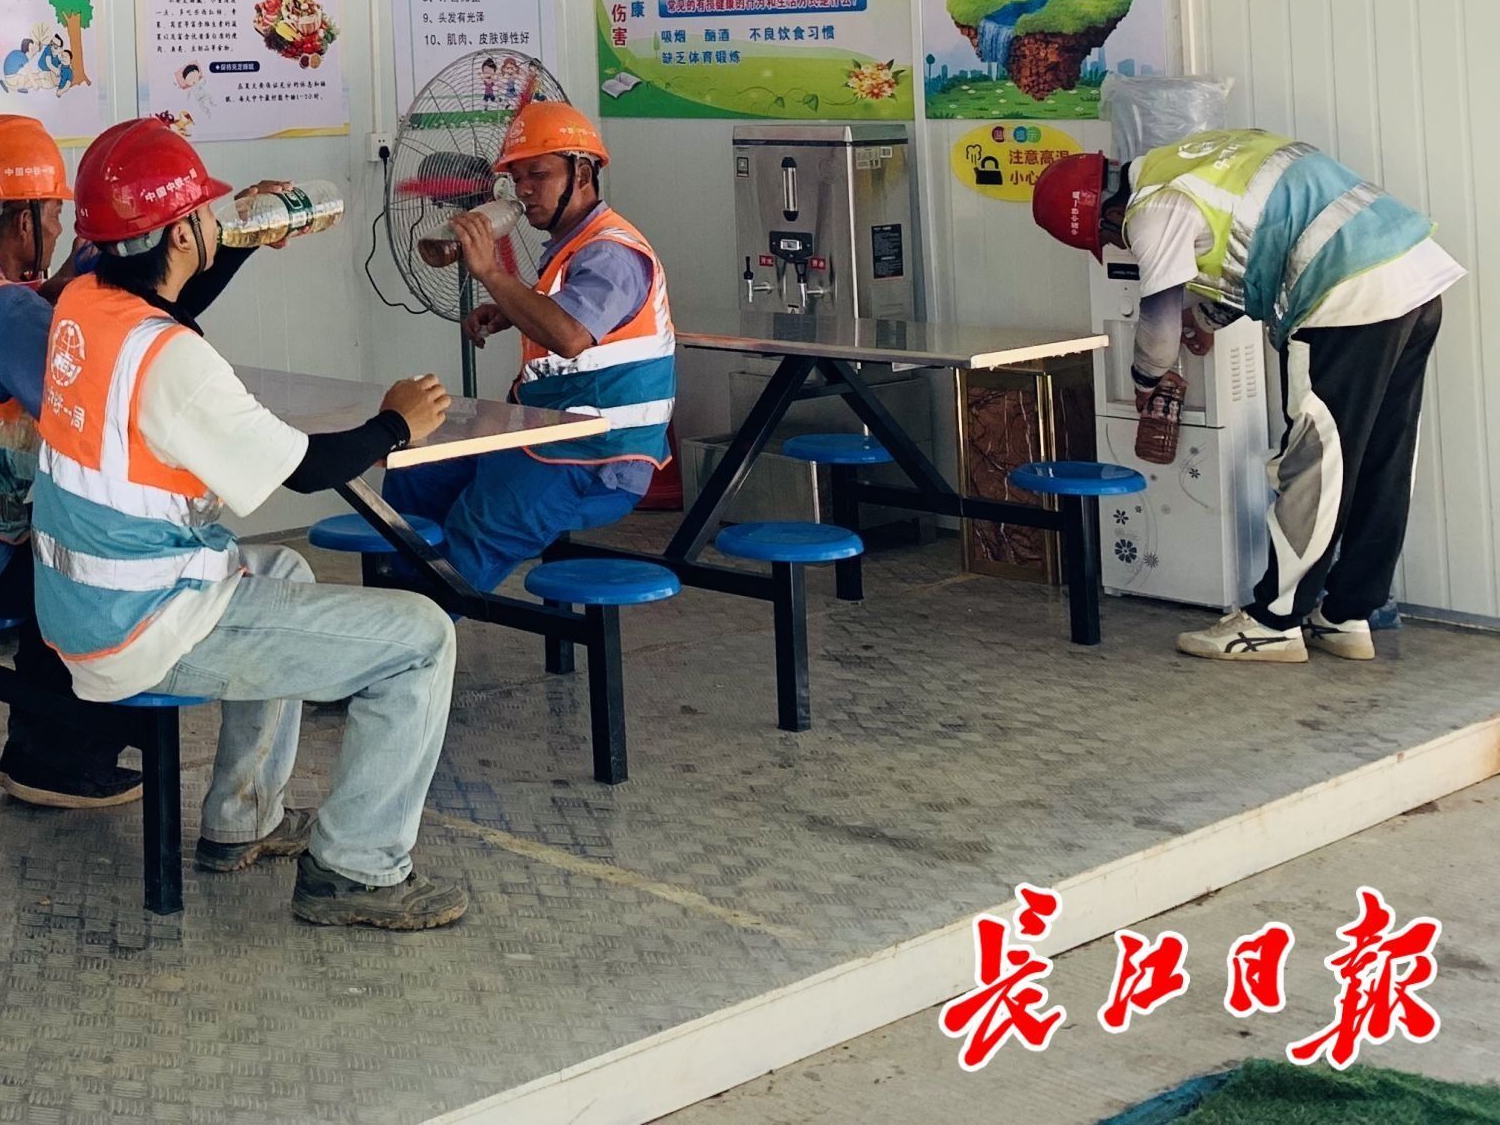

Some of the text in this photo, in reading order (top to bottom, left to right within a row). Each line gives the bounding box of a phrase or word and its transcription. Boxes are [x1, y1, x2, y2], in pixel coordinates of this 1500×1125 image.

[422, 11, 485, 24] 9、头发有光泽
[424, 31, 530, 46] 10、肌肉、皮肤弹性好
[661, 25, 836, 44] 吸烟 酗酒 不良饮食习惯
[662, 50, 742, 65] 缺乏体育锻炼
